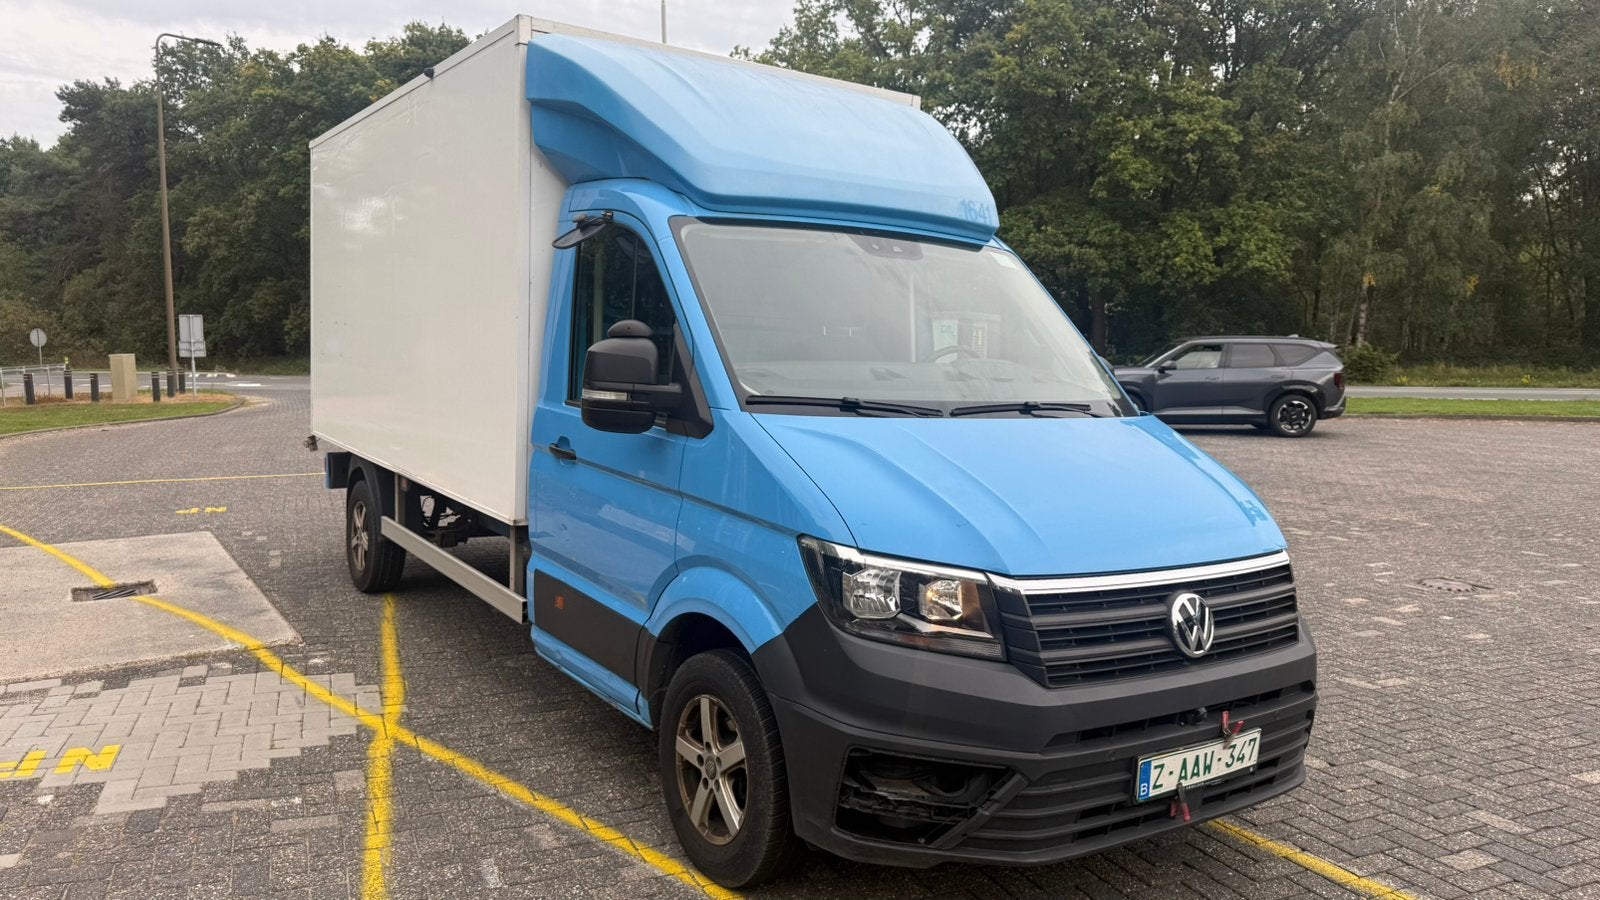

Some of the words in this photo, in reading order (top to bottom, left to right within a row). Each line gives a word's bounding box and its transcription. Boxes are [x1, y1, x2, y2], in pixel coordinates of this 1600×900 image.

[960, 199, 992, 225] 1641
[1152, 737, 1258, 790] Z-AAW-347
[1140, 783, 1148, 796] B
